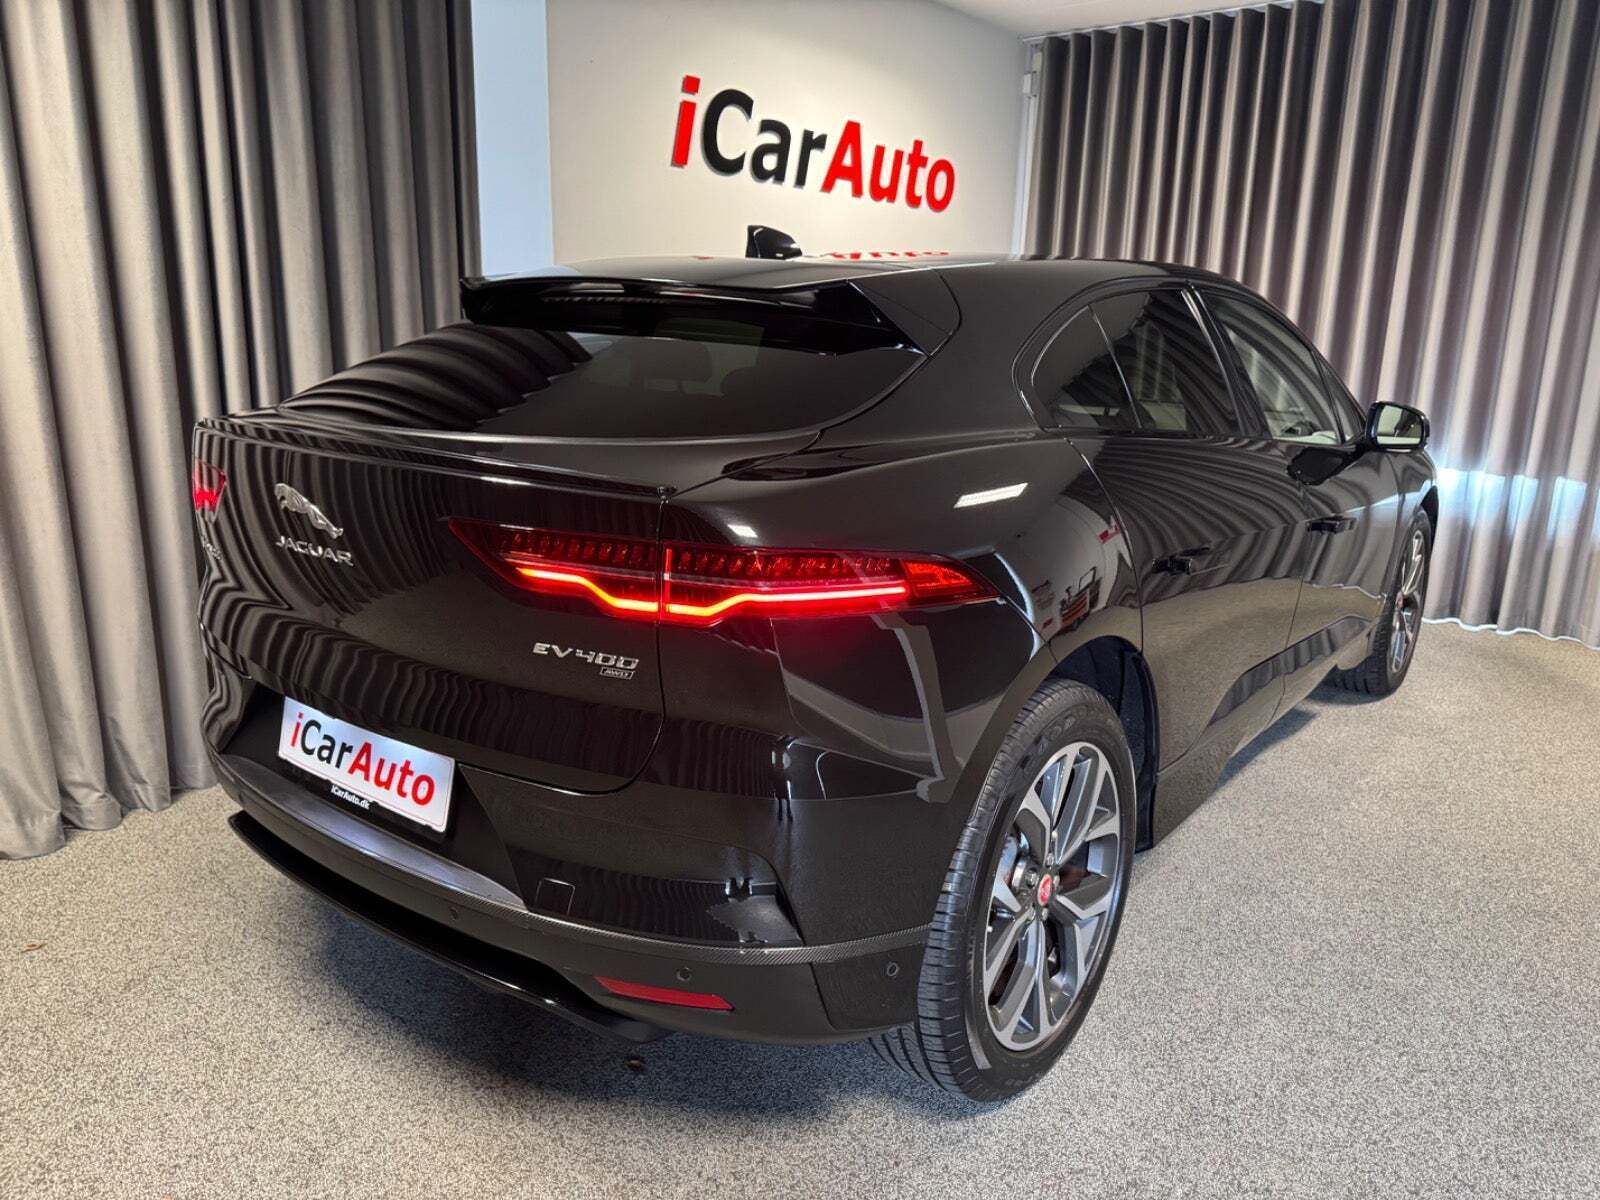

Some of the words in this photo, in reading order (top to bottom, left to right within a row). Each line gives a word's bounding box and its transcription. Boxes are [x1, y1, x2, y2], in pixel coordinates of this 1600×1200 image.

[671, 75, 955, 213] iCarAuto
[275, 535, 354, 567] JAGUAR
[533, 642, 640, 670] EV400
[290, 713, 435, 807] iCarAuto
